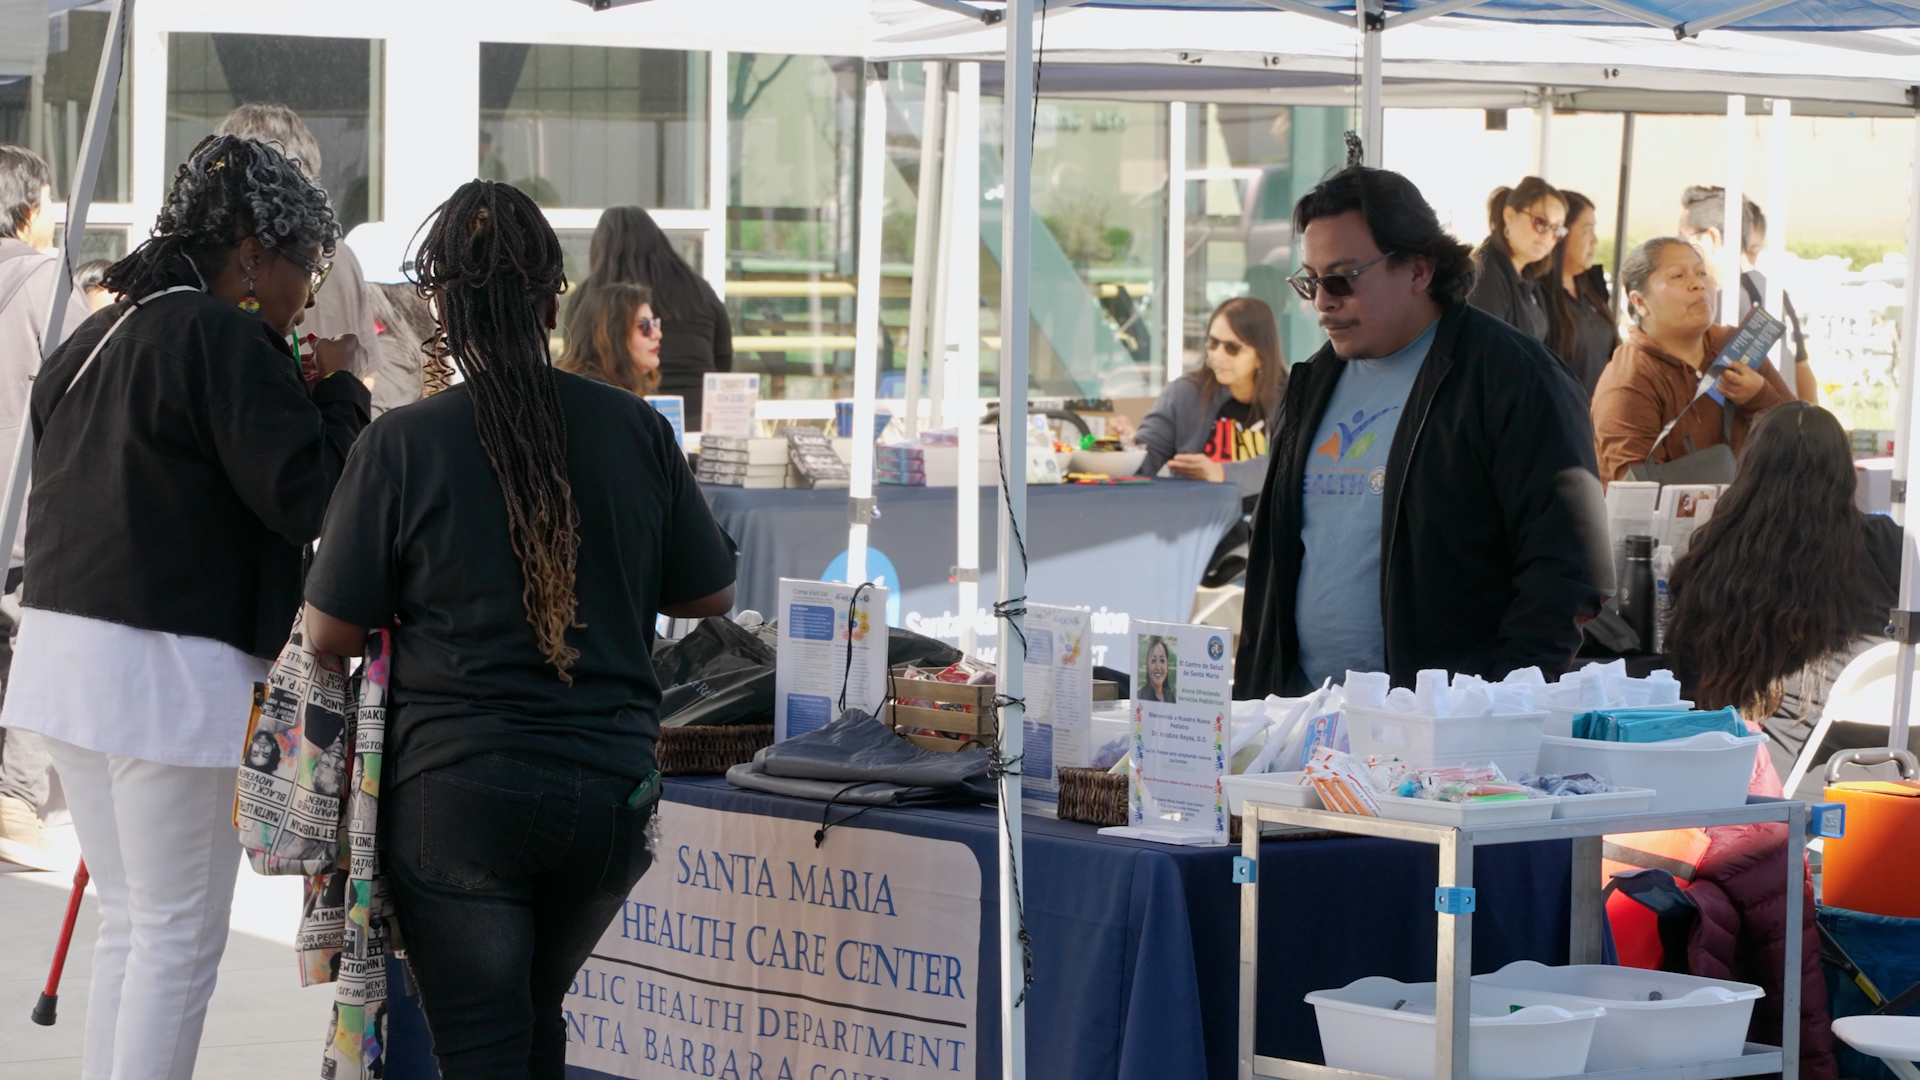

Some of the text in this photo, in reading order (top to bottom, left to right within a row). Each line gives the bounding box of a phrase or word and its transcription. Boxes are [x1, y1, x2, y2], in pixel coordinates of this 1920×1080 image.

[1185, 661, 1201, 669] Centro
[255, 804, 282, 823] MARTIN
[256, 786, 286, 802] BLACK
[677, 844, 898, 917] SANTA MARIA
[622, 900, 966, 1000] HEALTH CARE CENTER
[564, 1010, 629, 1055] NTA
[636, 980, 744, 1033] HEALTH
[757, 1006, 966, 1072] DEPARTMENT
